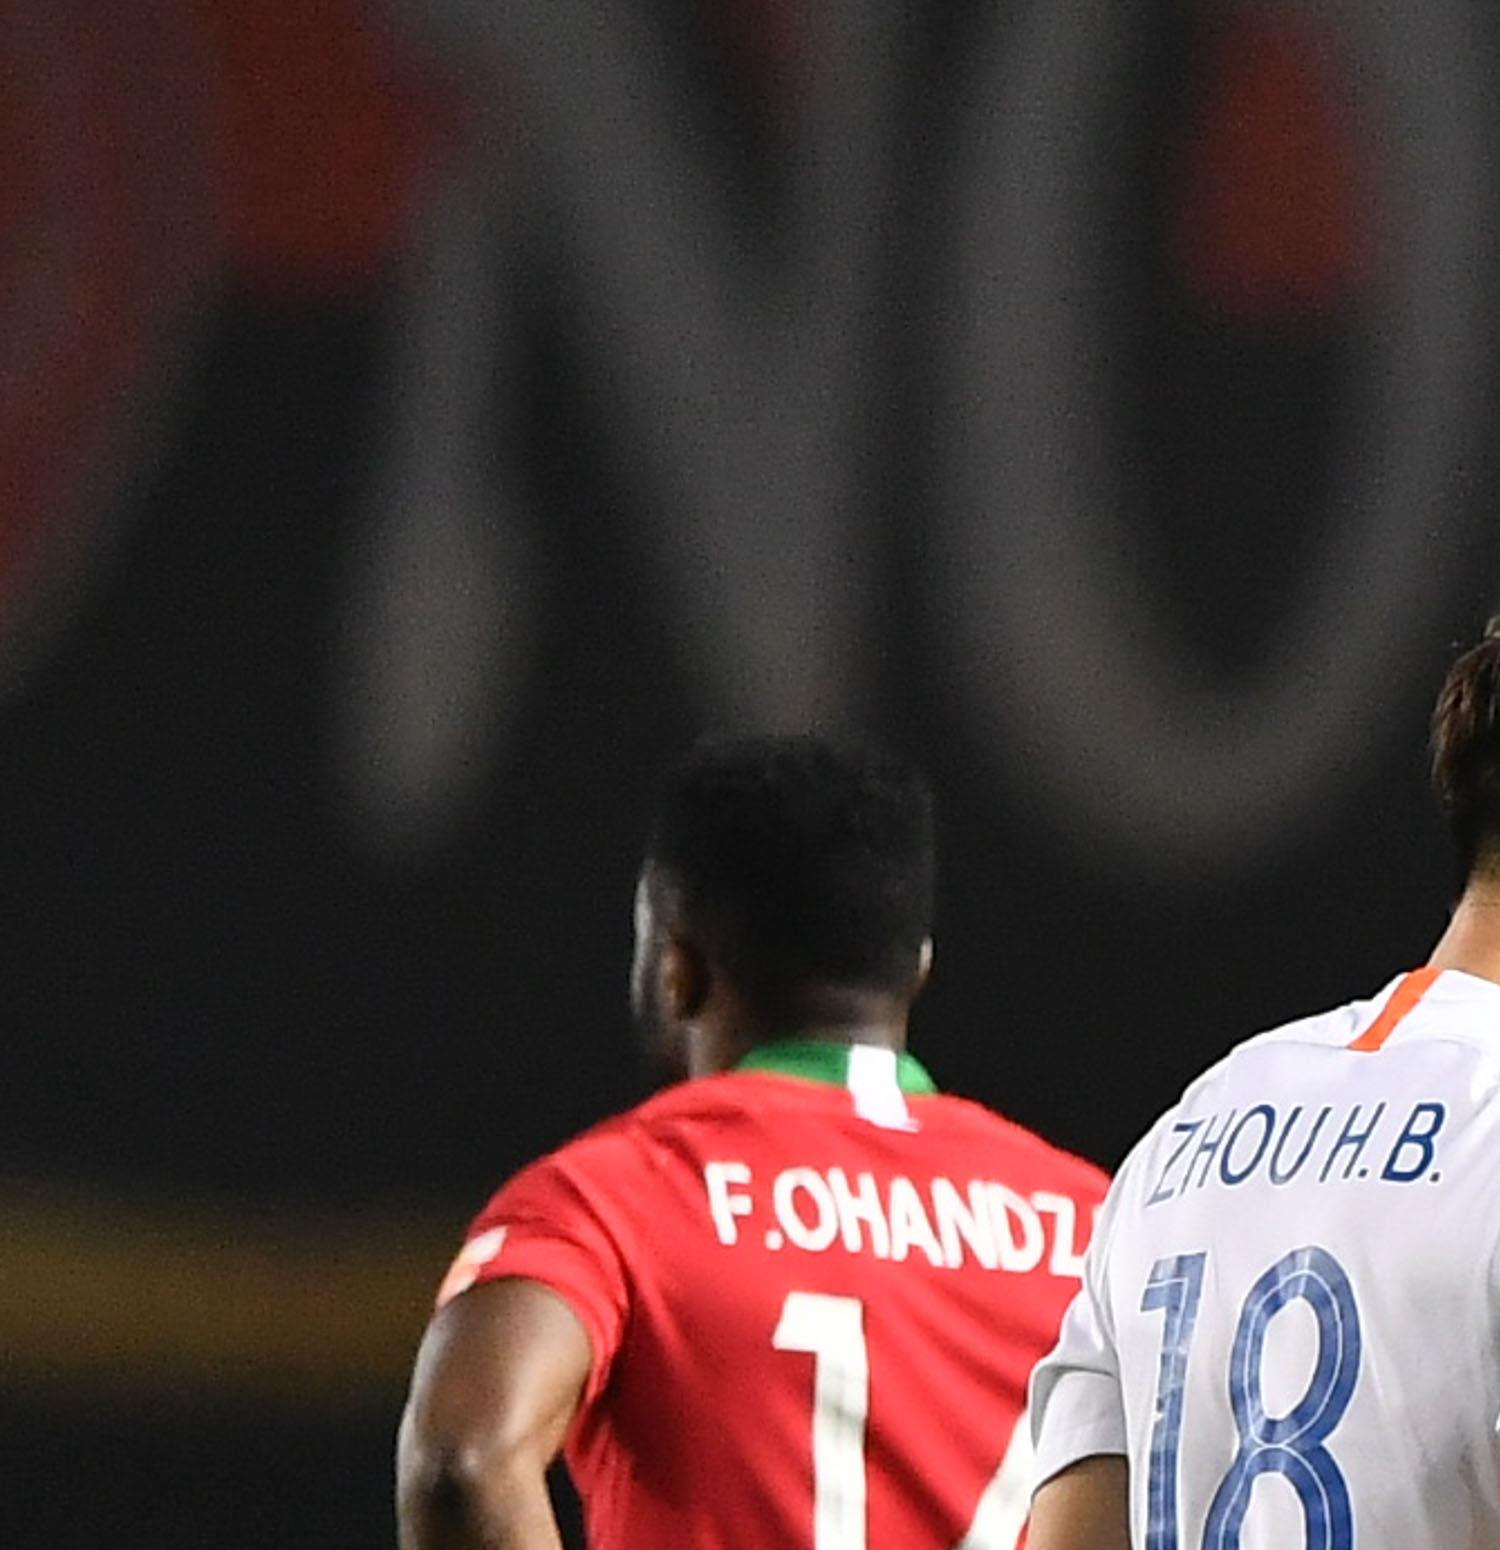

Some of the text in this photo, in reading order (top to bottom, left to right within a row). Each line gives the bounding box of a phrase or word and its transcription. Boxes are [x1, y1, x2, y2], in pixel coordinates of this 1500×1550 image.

[1145, 1101, 1444, 1206] ZHOU H.B.
[704, 1162, 1100, 1277] F.OHANDZ
